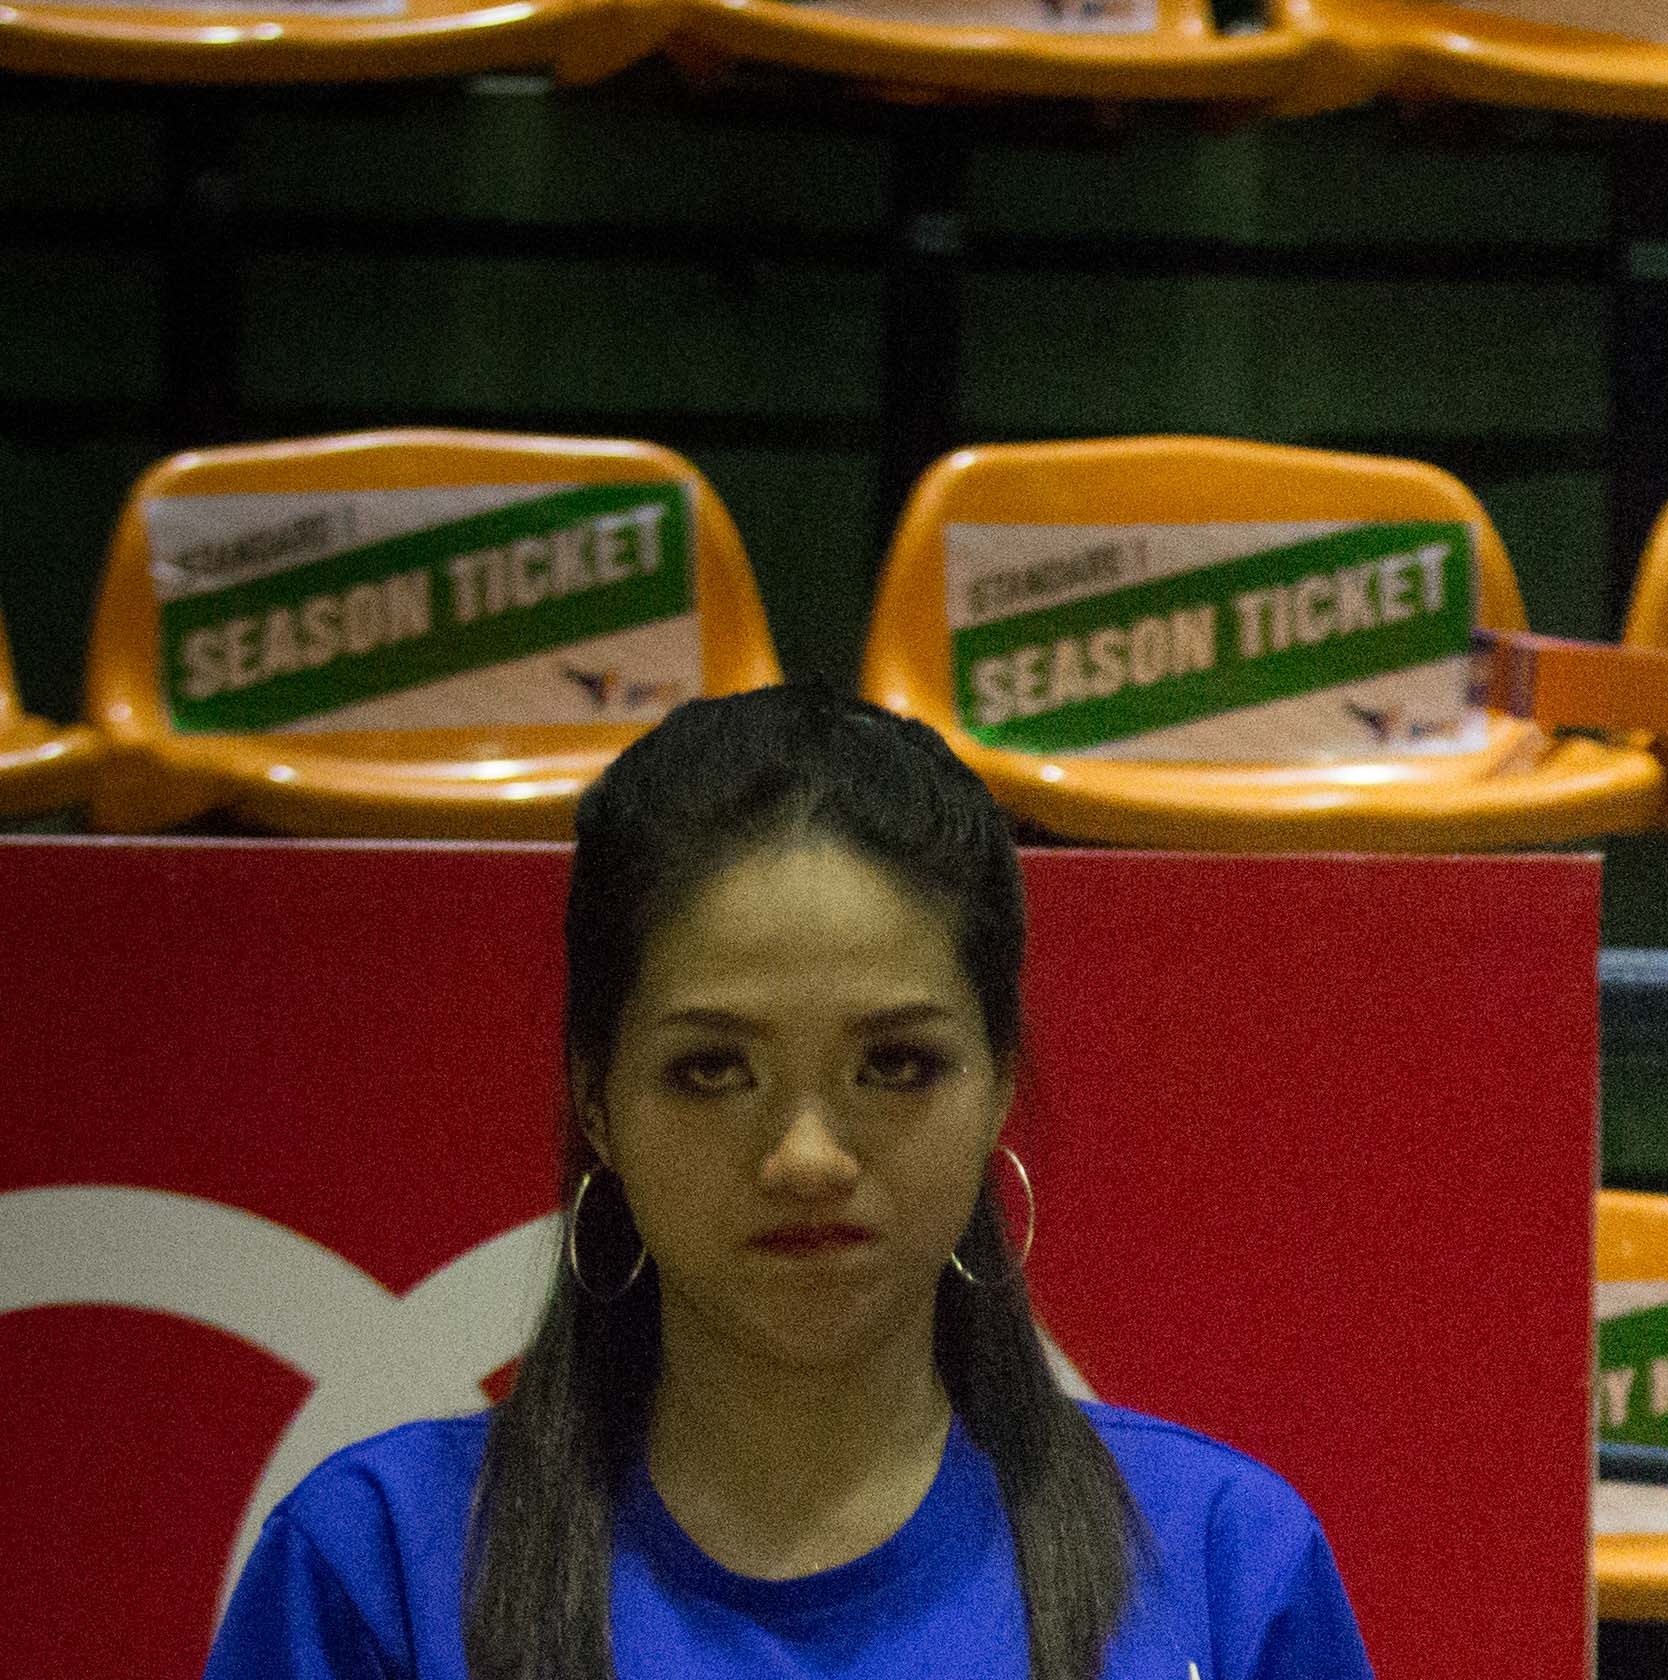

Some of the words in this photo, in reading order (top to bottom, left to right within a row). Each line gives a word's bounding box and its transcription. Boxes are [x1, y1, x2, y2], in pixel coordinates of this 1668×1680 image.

[181, 568, 431, 699] SEASON
[450, 503, 665, 625] TICKET
[972, 605, 1216, 727] SEASON
[1235, 545, 1450, 659] TICKET
